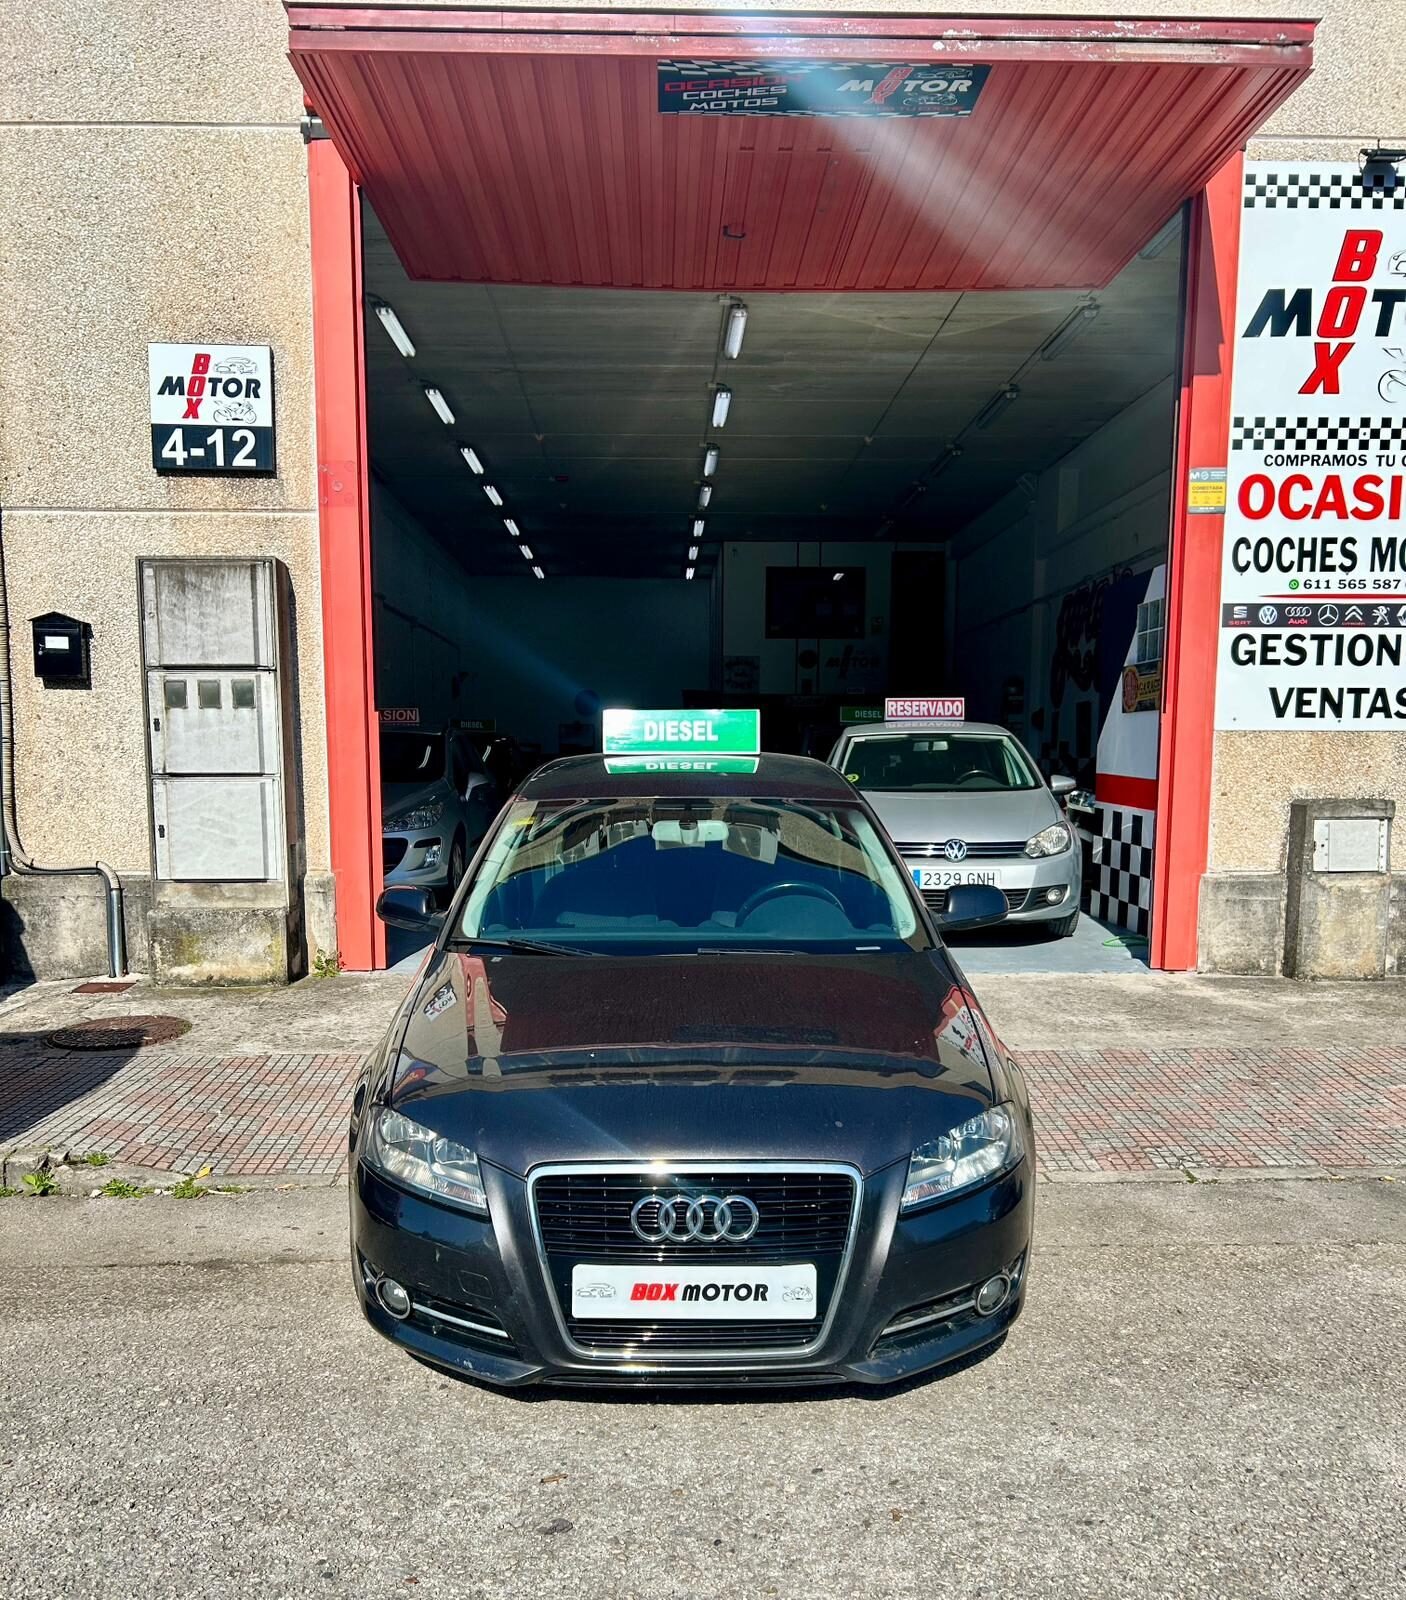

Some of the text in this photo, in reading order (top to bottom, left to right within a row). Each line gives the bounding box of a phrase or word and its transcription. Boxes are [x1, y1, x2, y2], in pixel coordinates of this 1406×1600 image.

[683, 86, 787, 100] COCHES
[690, 97, 778, 110] MOTOS
[1242, 288, 1406, 337] MOT
[1298, 229, 1383, 394] BOX
[157, 376, 261, 398] MOTOR
[182, 353, 211, 419] BOX
[161, 428, 257, 467] 4-12
[1264, 454, 1367, 467] COMPRAMOS
[1376, 454, 1396, 467] TU
[1238, 473, 1403, 520] OCASI
[1232, 537, 1358, 573] COCHES
[1303, 579, 1331, 590] 611
[1338, 579, 1366, 590] 565
[1373, 579, 1401, 590] 587
[1231, 633, 1402, 667] GESTION
[380, 709, 416, 721] SION
[855, 710, 882, 719] DIESEL
[888, 701, 961, 716] RESERVADO
[644, 720, 719, 742] DIESEL
[924, 872, 962, 886] 2329
[967, 872, 995, 885] GNH
[630, 1283, 768, 1302] BOX MOTOR
